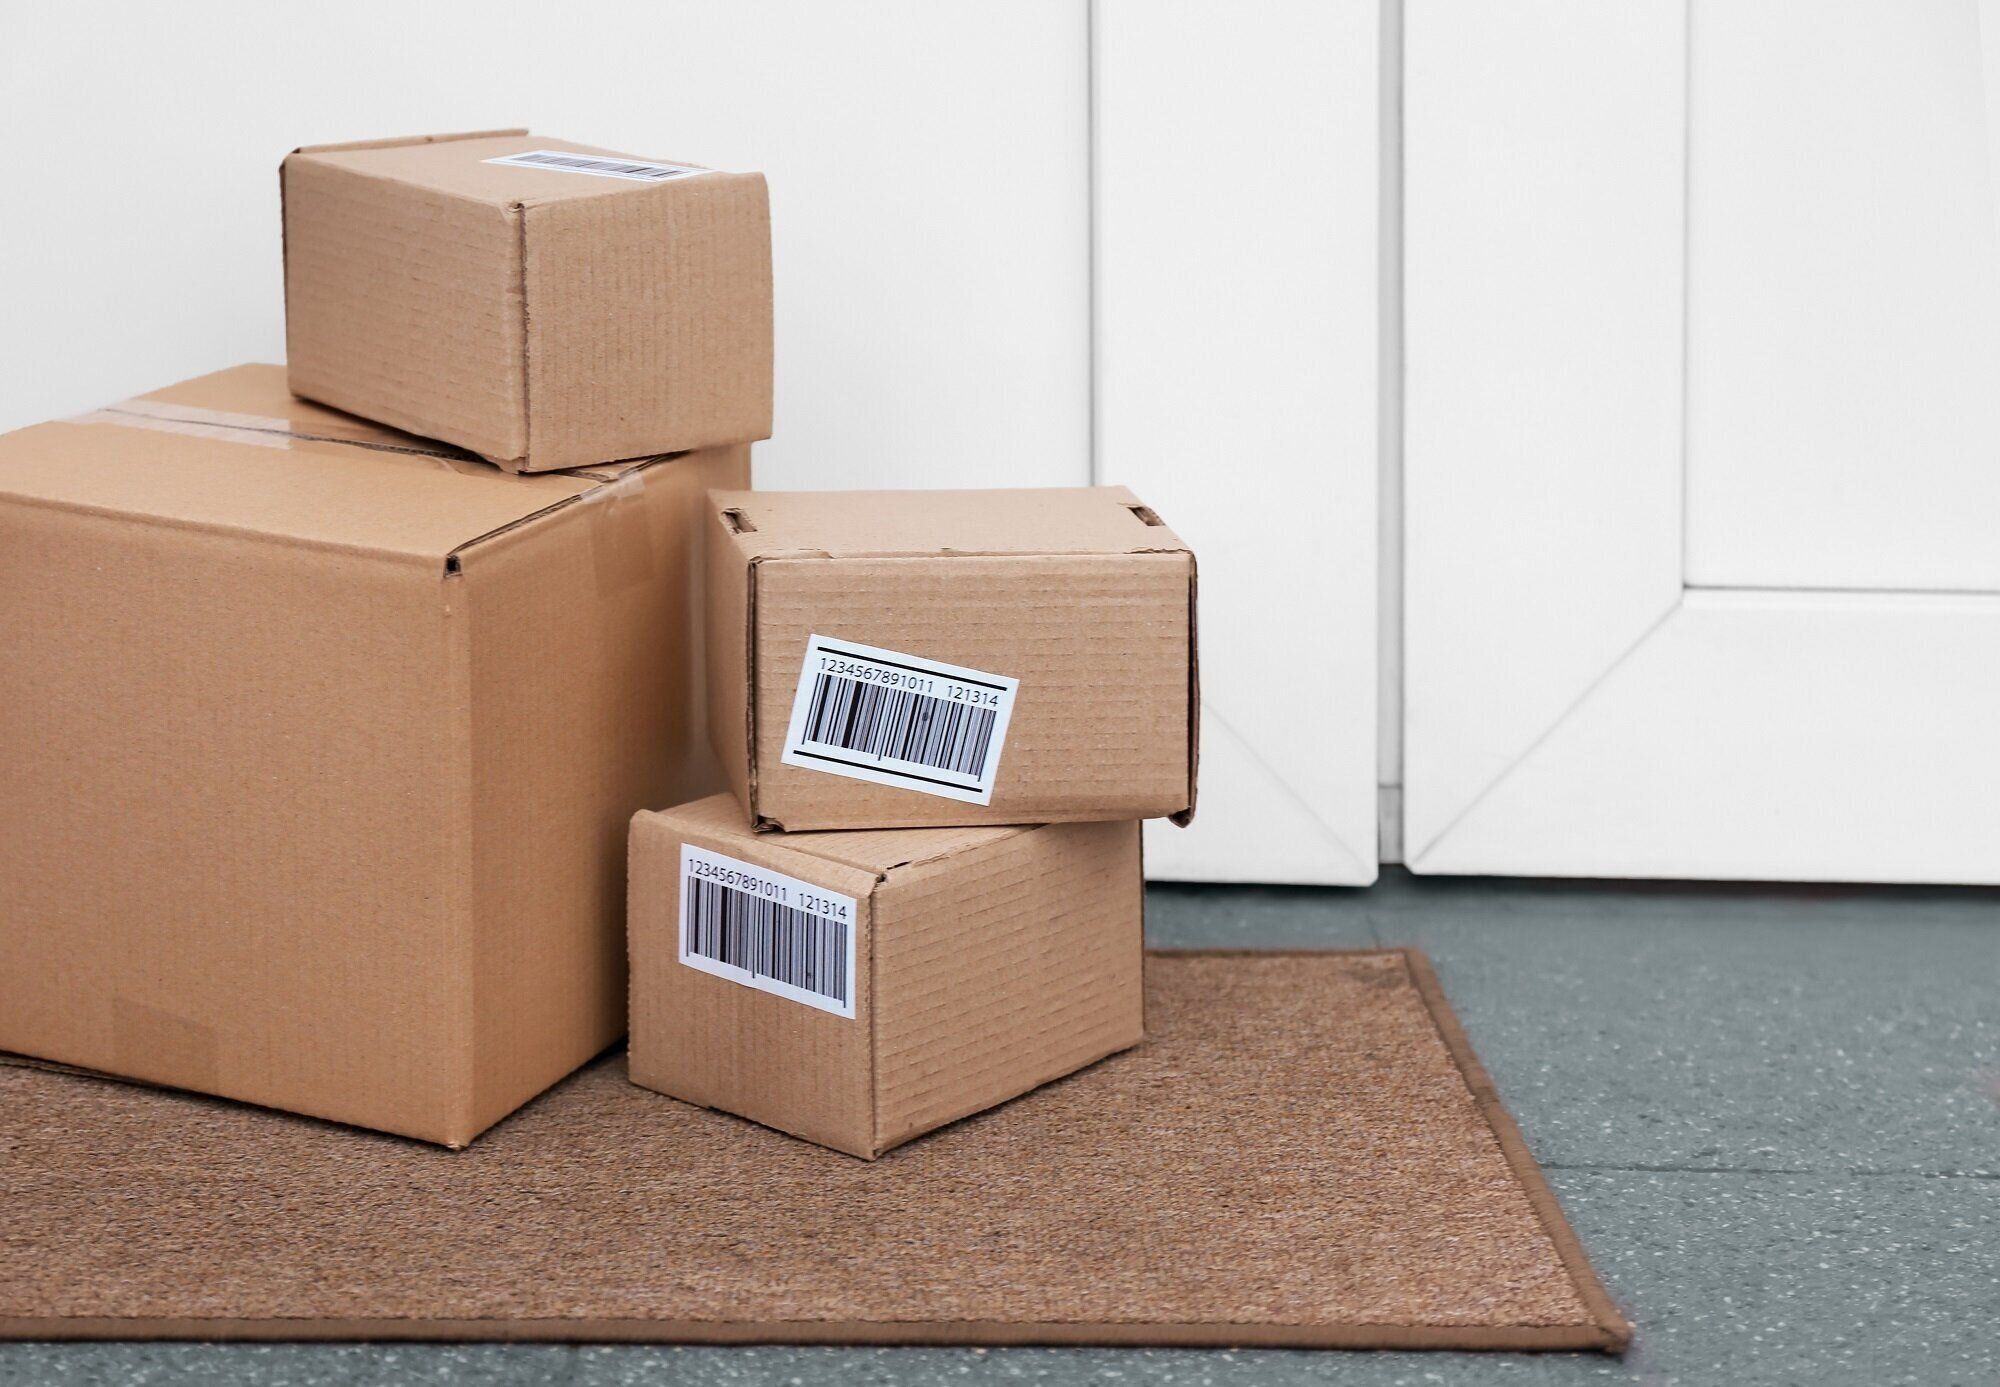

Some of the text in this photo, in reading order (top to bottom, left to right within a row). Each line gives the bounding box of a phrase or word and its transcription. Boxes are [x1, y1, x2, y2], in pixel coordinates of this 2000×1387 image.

[820, 658, 999, 707] 1234567891011 121314
[688, 859, 847, 919] 1234567891011 121314
